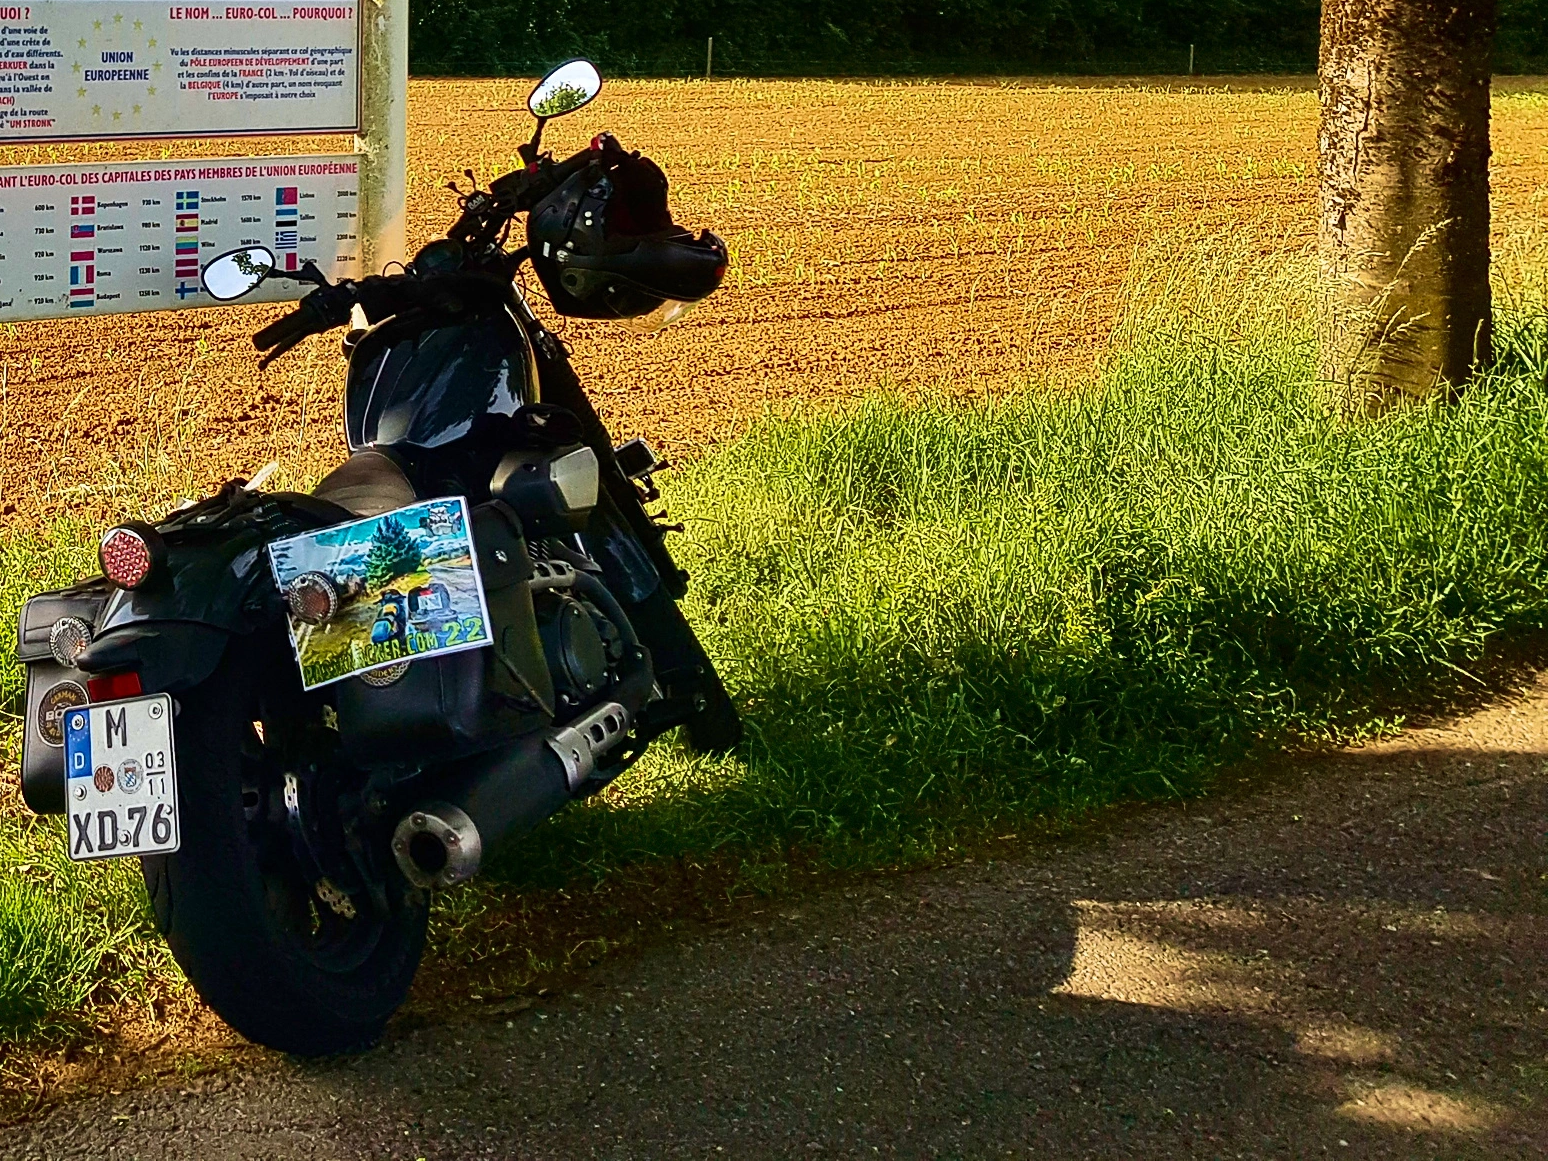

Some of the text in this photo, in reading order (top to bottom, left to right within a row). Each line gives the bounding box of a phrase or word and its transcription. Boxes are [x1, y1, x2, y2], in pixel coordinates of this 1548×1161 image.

[25, 7, 29, 20] ?
[170, 7, 182, 19] LE
[185, 7, 209, 19] NOM
[226, 7, 277, 19] EURO-COL
[293, 7, 345, 21] POURQUOI
[348, 7, 353, 19] ?
[1, 25, 21, 35] d'une
[23, 25, 37, 34] voie
[39, 25, 48, 34] de
[0, 37, 20, 46] d'une
[22, 37, 40, 46] crête
[42, 37, 50, 46] de
[4, 49, 24, 58] d'eau
[26, 49, 63, 58] différents.
[102, 52, 133, 63] UNION
[29, 61, 46, 70] dans
[48, 60, 54, 69] la
[85, 69, 149, 81] EUROPEENNE
[10, 107, 18, 116] de
[20, 107, 27, 116] la
[20, 173, 78, 187] L'EURO-COL
[81, 172, 99, 185] DES
[102, 167, 151, 184] CAPITALES
[154, 169, 171, 182] DES
[174, 168, 196, 181] PAYS
[199, 166, 242, 180] MEMBRES
[245, 166, 257, 178] DE
[260, 165, 296, 177] L'UNION
[299, 161, 358, 176] EUROPÉENNE
[441, 616, 486, 647] 22
[105, 707, 127, 749] M
[74, 752, 85, 770] D
[145, 751, 165, 770] 03
[148, 778, 165, 796] 11
[73, 803, 172, 855] XD 76
